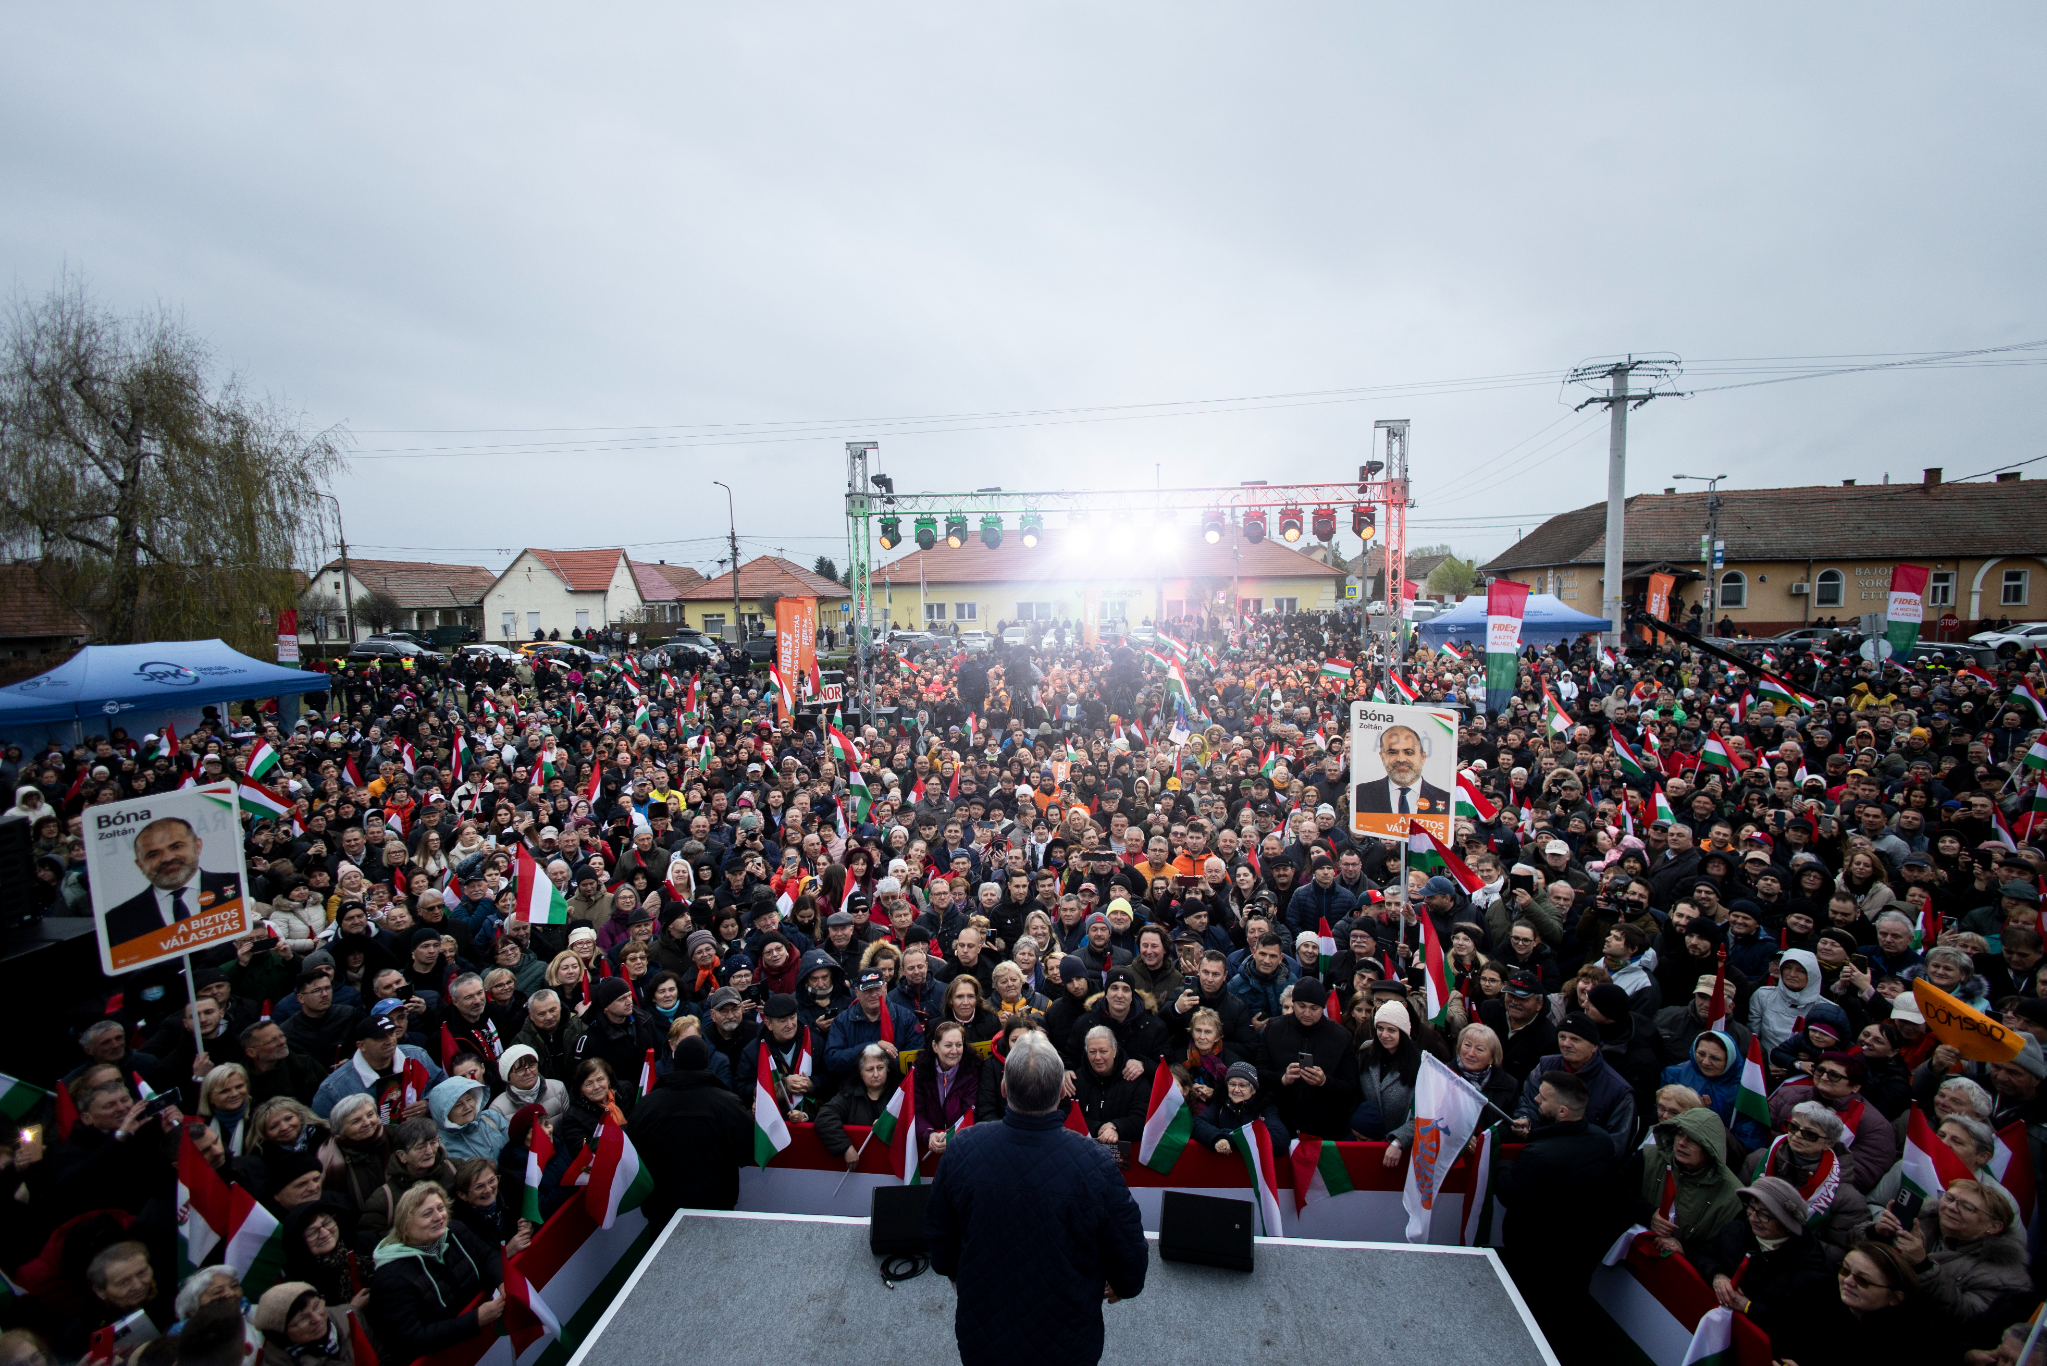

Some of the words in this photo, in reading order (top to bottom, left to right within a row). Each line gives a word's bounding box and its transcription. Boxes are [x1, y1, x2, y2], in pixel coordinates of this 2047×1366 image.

[1940, 619, 1958, 627] STOP
[781, 631, 793, 675] FIDESZ
[1359, 709, 1394, 723] Bóna
[1359, 722, 1383, 731] Zoltán
[96, 808, 153, 830] Bóna
[1398, 816, 1407, 824] A
[97, 826, 136, 841] Zoltán
[177, 923, 189, 934] A
[190, 908, 239, 930] BIZTOS
[159, 919, 241, 951] VÁLASZTÁS
